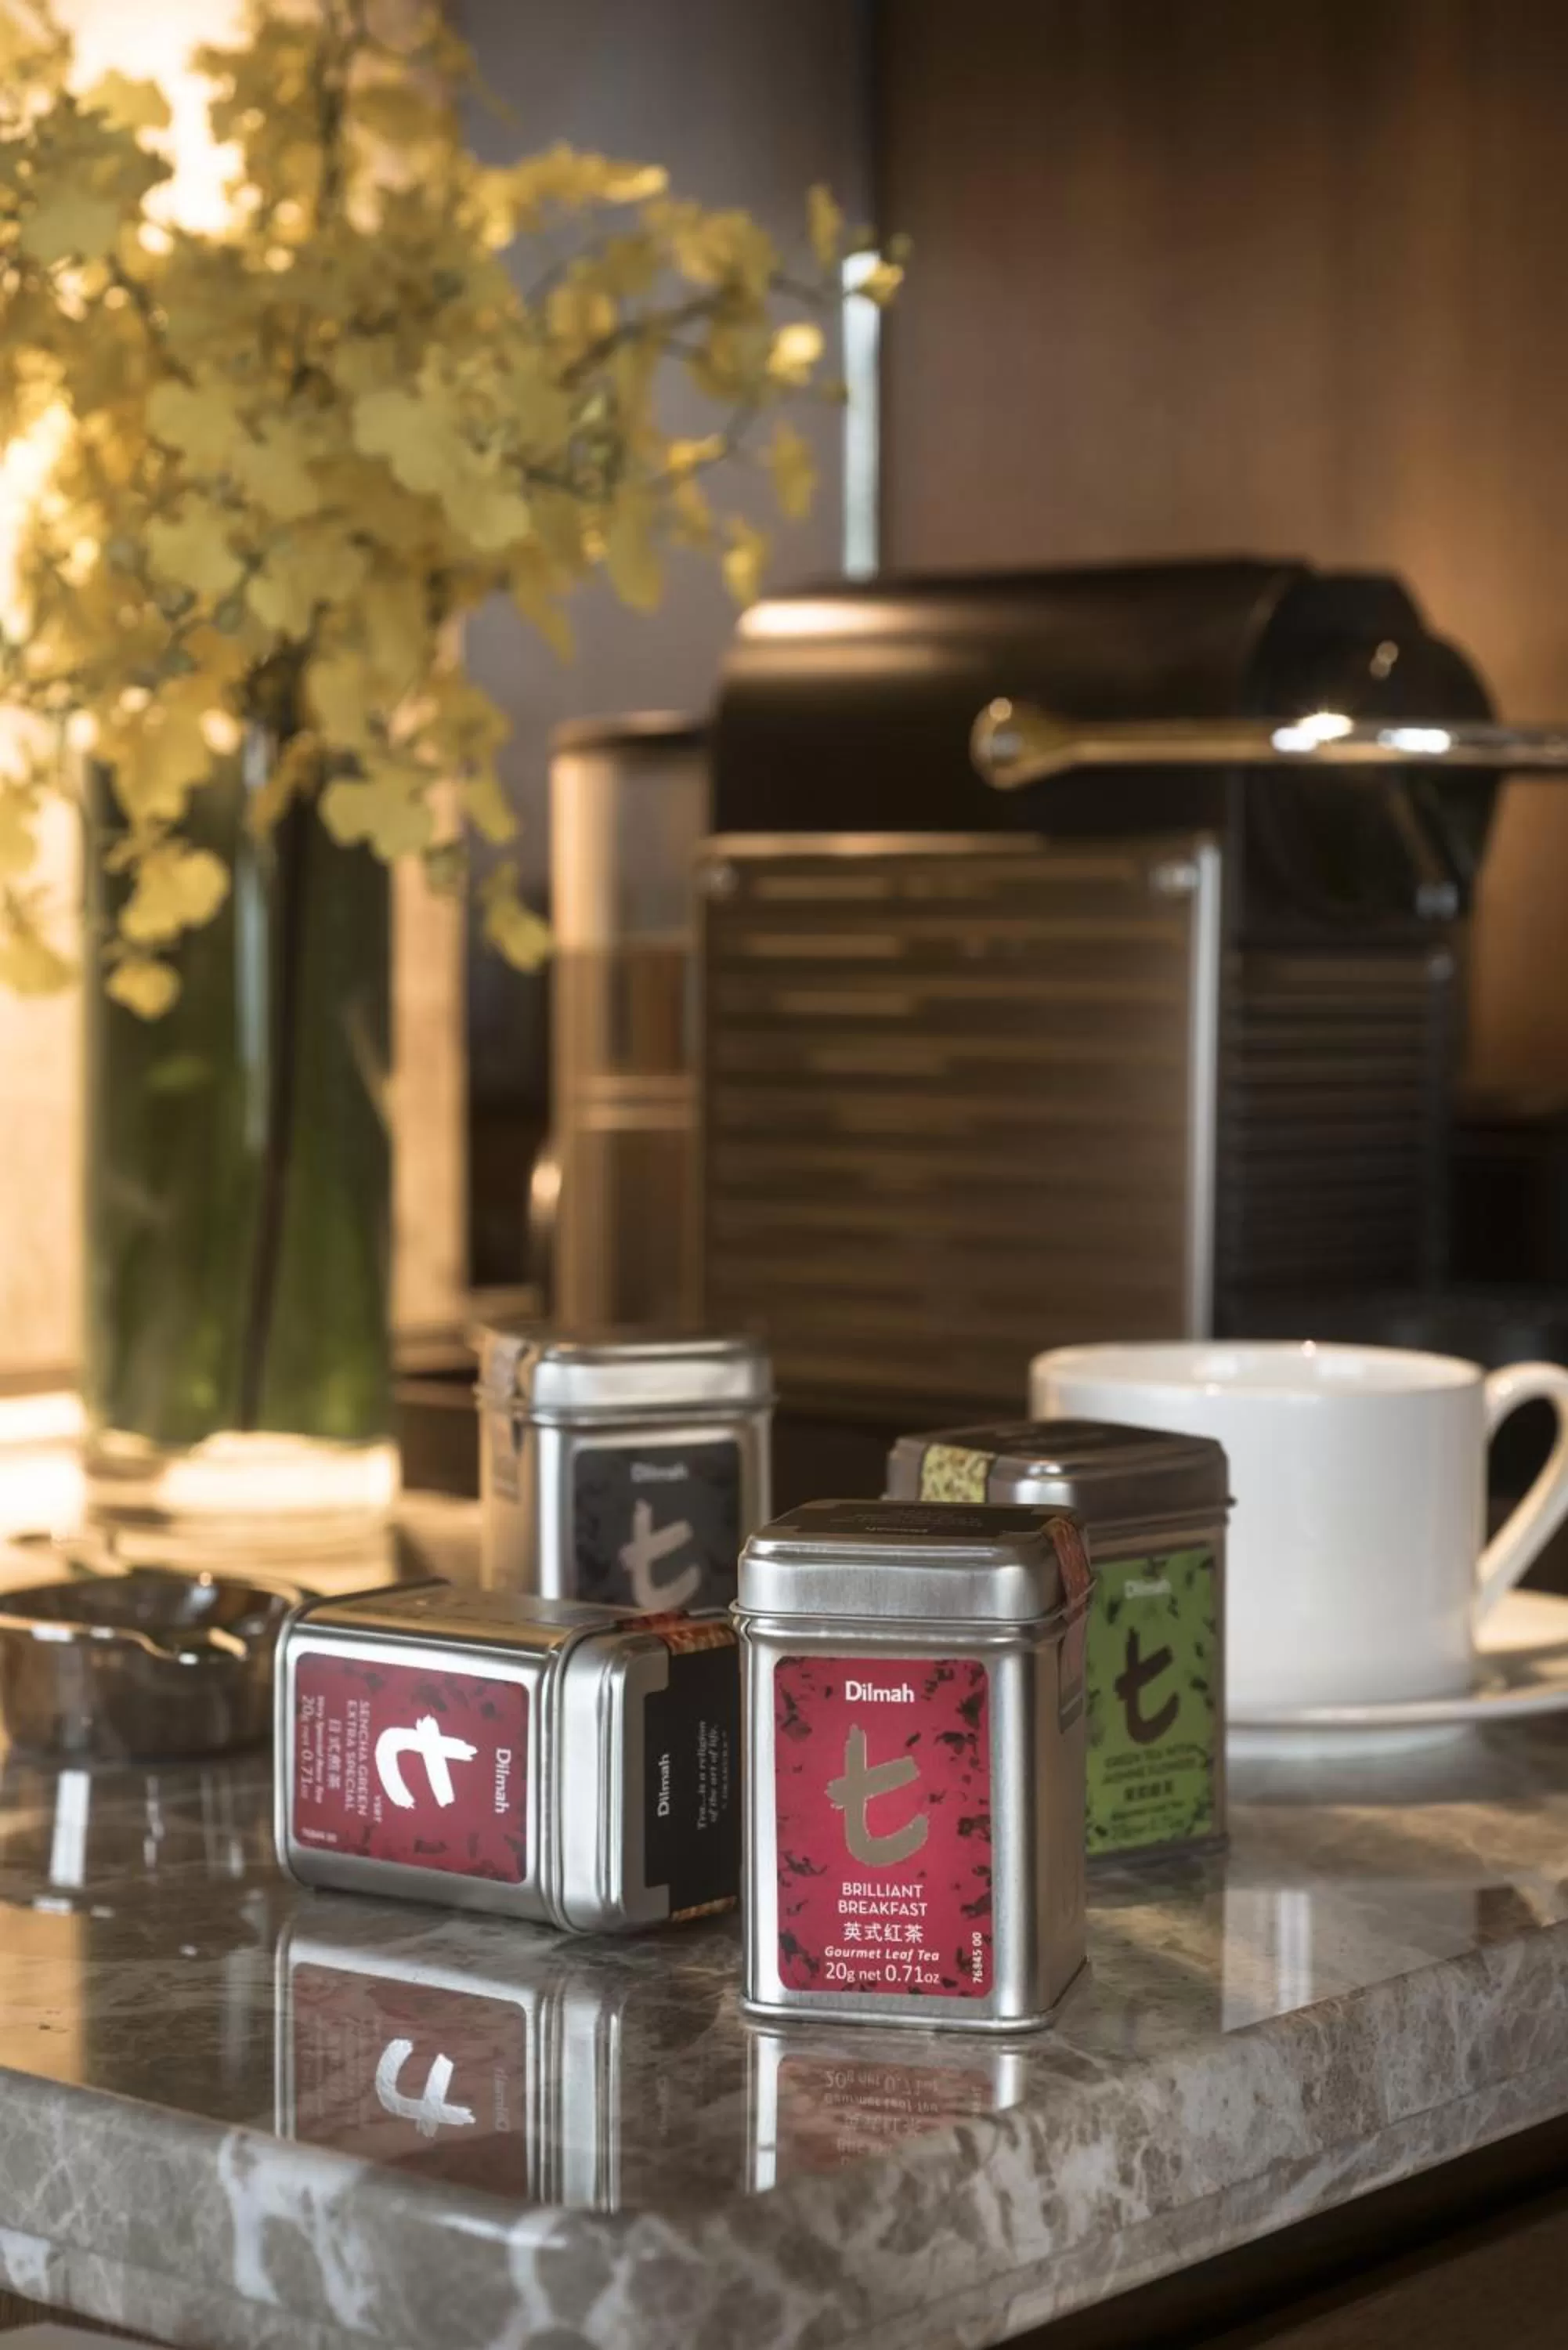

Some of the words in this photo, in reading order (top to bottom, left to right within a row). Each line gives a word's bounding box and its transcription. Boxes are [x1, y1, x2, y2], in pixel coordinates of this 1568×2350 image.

[845, 1680, 916, 1703] Dilmah
[345, 1700, 357, 1748] EXTRA
[358, 1699, 370, 1762] SENCHA
[345, 1751, 356, 1812] SPECIAL
[357, 1764, 369, 1817] GREEN
[493, 1747, 512, 1815] Dilmah
[657, 1753, 670, 1817] Dilmah
[838, 1900, 928, 1917] BREAKFAST
[842, 1882, 924, 1899] BRILLIANT
[825, 1946, 881, 1959] Gourmet
[885, 1949, 914, 1962] Leaf
[917, 1950, 940, 1961] Tea
[826, 1962, 856, 1983] 20g
[858, 1969, 881, 1982] net
[885, 1965, 940, 1984] 0.71oz
